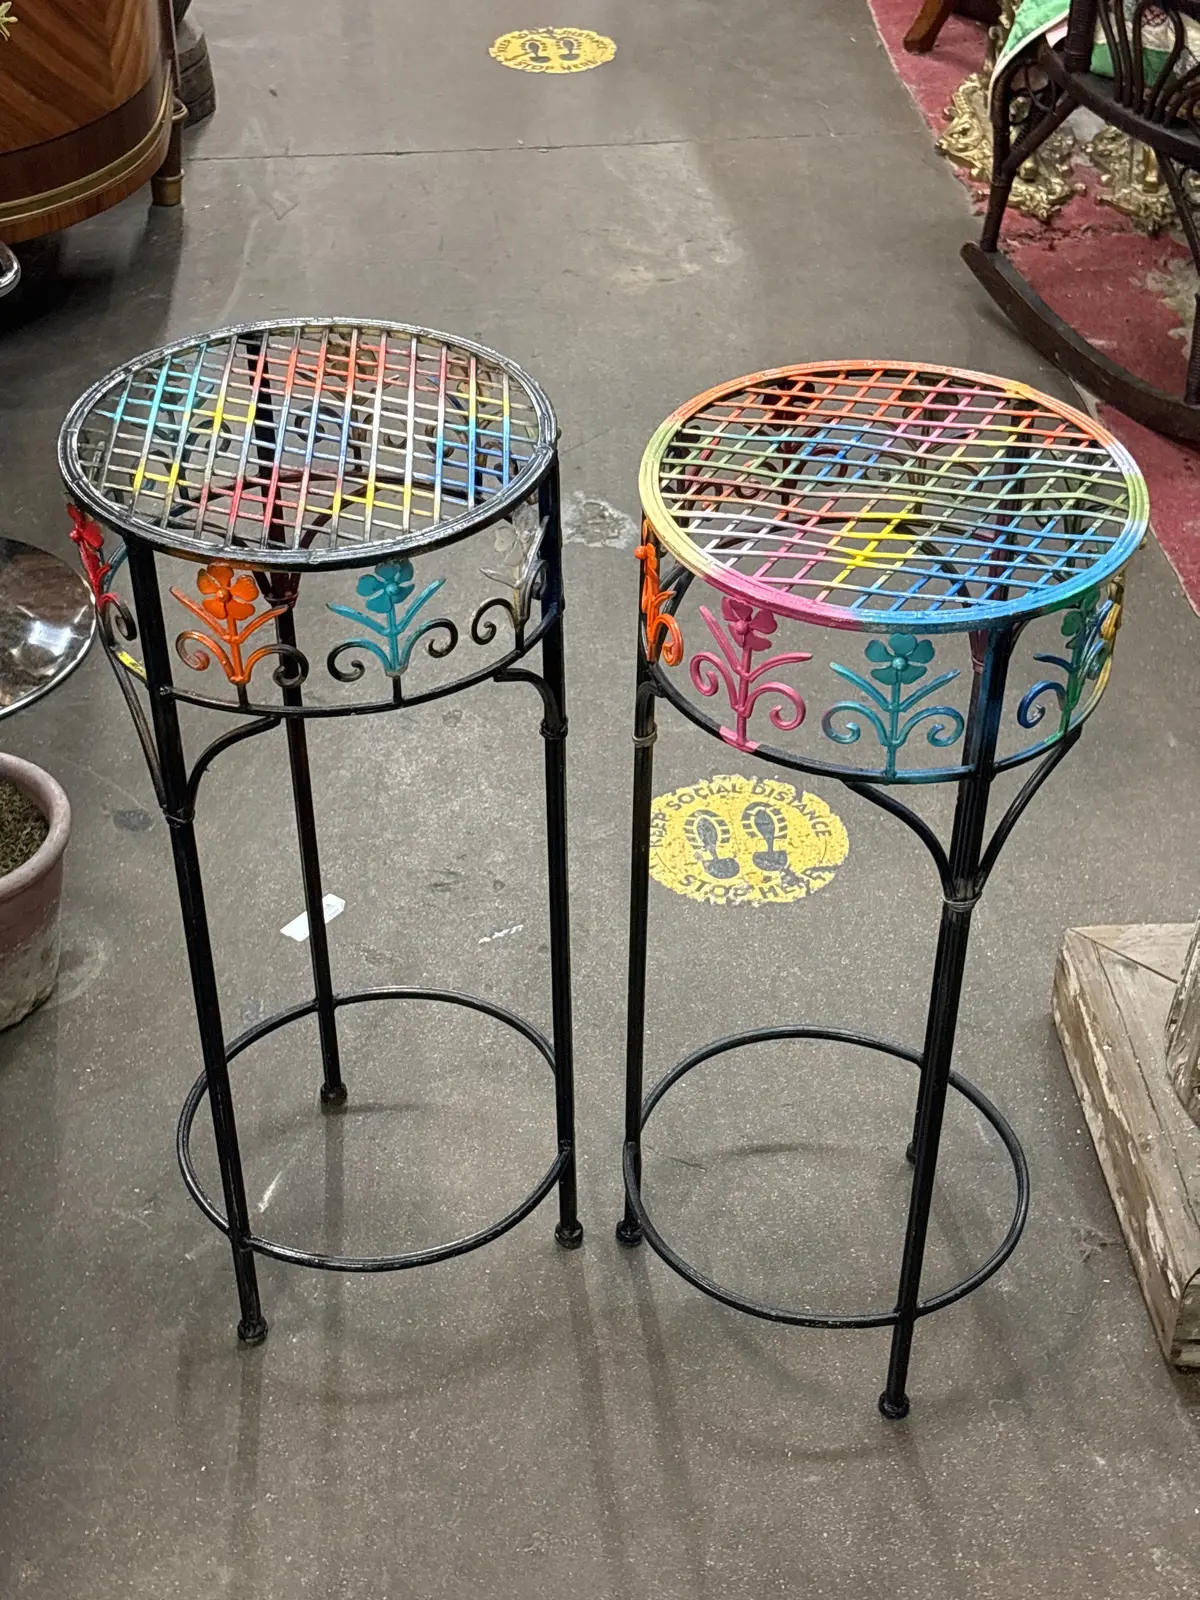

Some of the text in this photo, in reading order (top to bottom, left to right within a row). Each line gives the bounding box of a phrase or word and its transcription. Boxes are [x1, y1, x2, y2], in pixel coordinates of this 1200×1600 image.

[514, 57, 598, 70] STOP HERE
[666, 783, 744, 810] SOCIAL
[751, 784, 832, 838] DISTANCE
[678, 874, 753, 899] STOP
